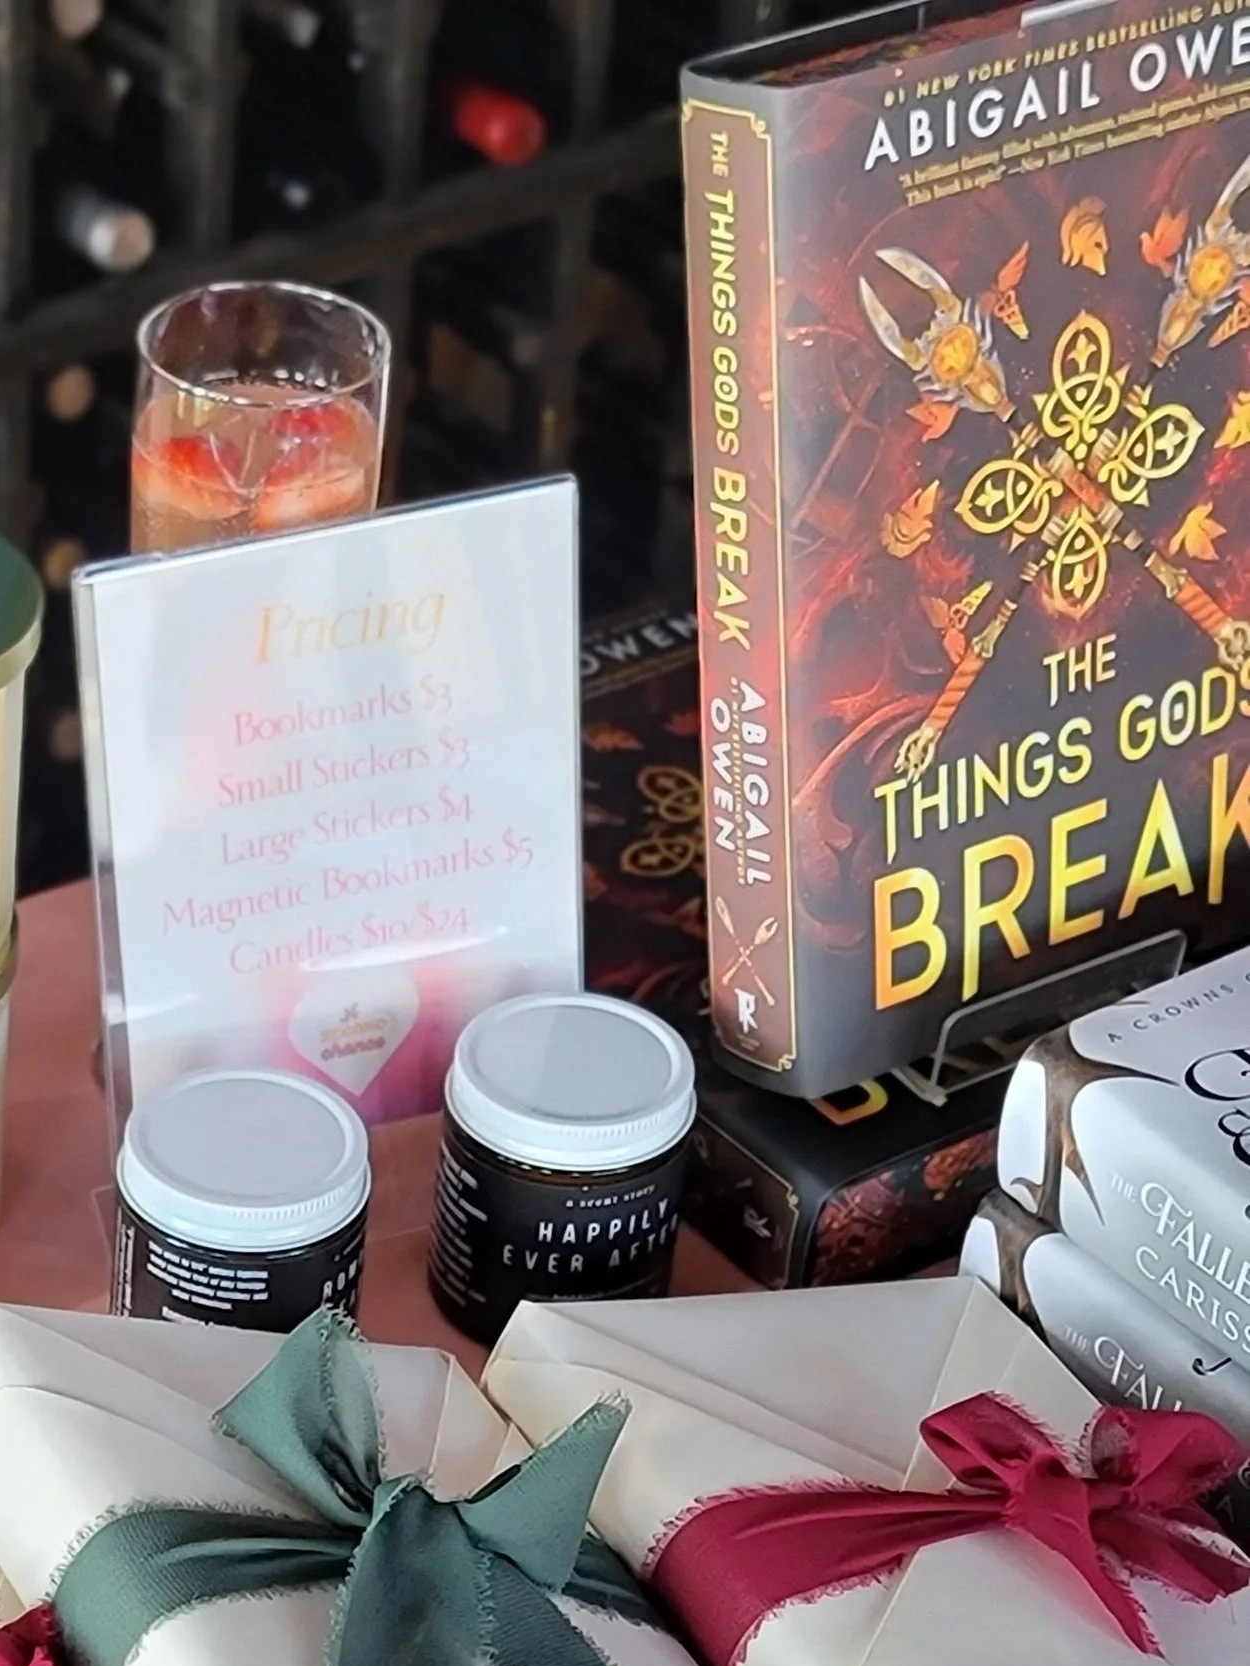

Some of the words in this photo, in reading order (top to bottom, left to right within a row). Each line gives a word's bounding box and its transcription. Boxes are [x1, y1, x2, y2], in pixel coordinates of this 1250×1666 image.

[916, 74, 960, 99] NEW
[968, 59, 1016, 85] YORK
[1024, 40, 1078, 69] TIMES
[1086, 5, 1203, 53] BESTSELLING
[710, 131, 729, 178] THE
[864, 60, 1100, 171] ABIGAIL
[705, 190, 738, 338] THINGS
[711, 345, 739, 457] GODS
[712, 470, 751, 651] BREAK
[255, 590, 446, 665] Pricing
[1043, 633, 1117, 707] THE
[235, 682, 412, 746] Bookmarks
[419, 672, 453, 713] $3
[218, 759, 303, 810] Small
[312, 741, 430, 791] Stickers
[438, 726, 471, 771] $3
[710, 697, 737, 852] OWEN
[740, 681, 772, 885] ABIGAIL
[874, 716, 1093, 864] THINGS
[221, 825, 306, 865] Large
[313, 801, 430, 846] Stickers
[438, 784, 475, 823] $4
[162, 878, 310, 935] Magnetic
[321, 838, 495, 901] Bookmarks
[501, 825, 535, 869] $5
[874, 752, 1250, 1012] BREAK
[230, 924, 352, 975] Candles
[1107, 1032, 1122, 1043] A
[1133, 983, 1234, 1031] CROWNS
[503, 1244, 584, 1274] EVER
[538, 1198, 668, 1244] HAPPILY
